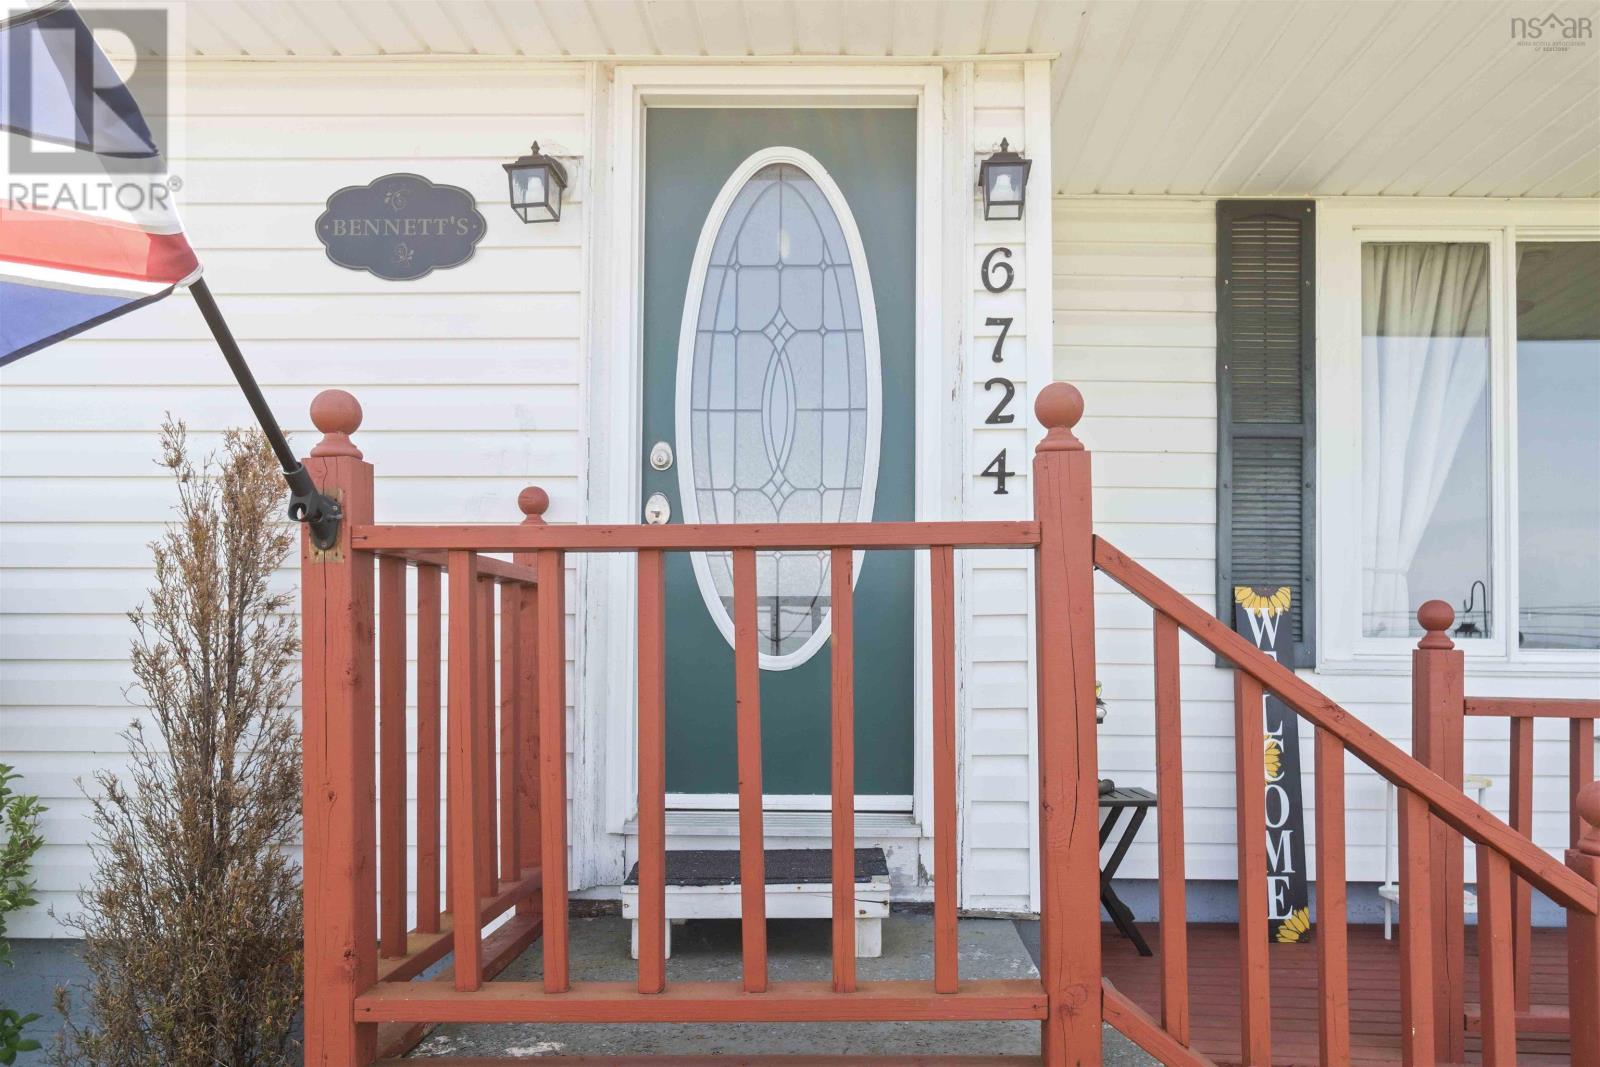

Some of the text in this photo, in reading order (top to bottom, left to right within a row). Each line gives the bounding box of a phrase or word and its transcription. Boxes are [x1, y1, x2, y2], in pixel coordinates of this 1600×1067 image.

[333, 216, 469, 236] BENNETT'S
[981, 247, 1016, 495] 6724
[1243, 607, 1296, 920] WLCOME
